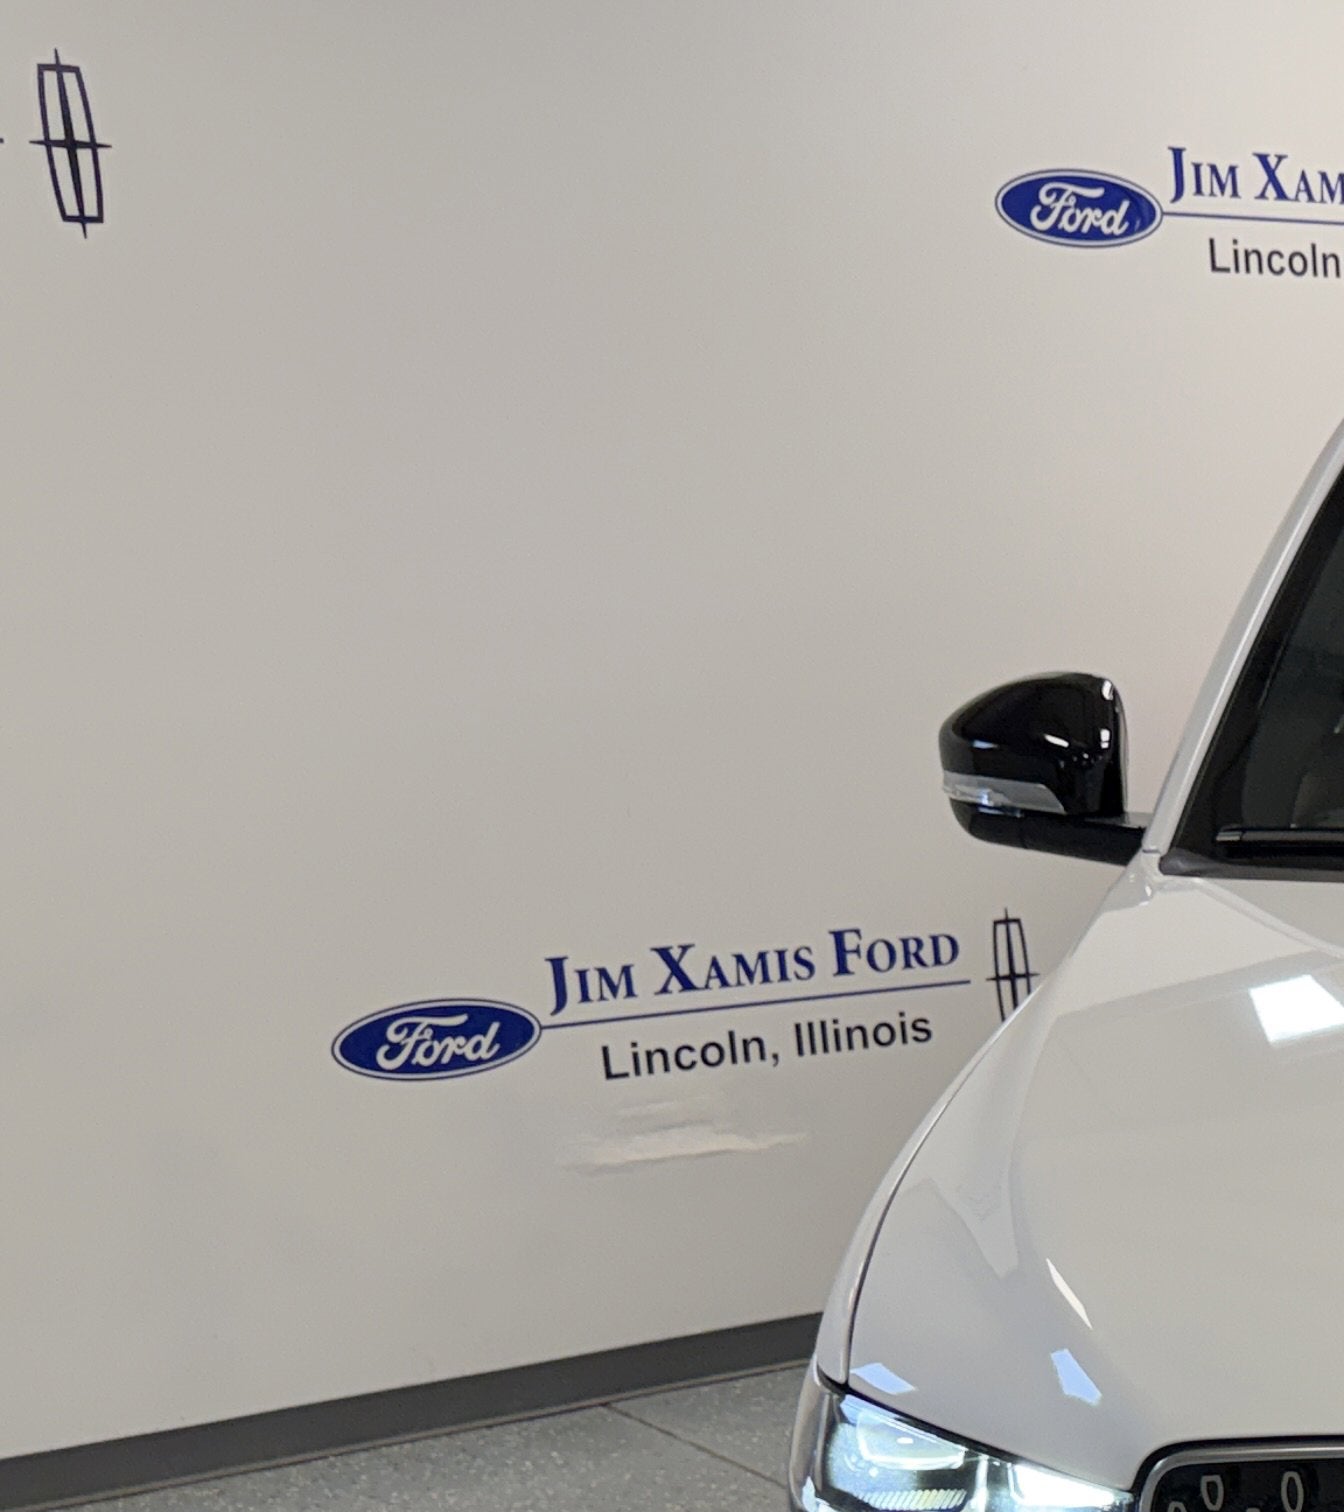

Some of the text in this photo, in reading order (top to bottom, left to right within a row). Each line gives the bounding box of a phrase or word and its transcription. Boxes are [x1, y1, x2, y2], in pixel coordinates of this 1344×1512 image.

[1167, 146, 1240, 204] JIM
[1029, 181, 1128, 235] Ford
[544, 928, 961, 1017] JIM XAMIS FORD
[374, 1013, 500, 1071] Ford
[601, 1010, 934, 1081] Lincoln, Illinois
